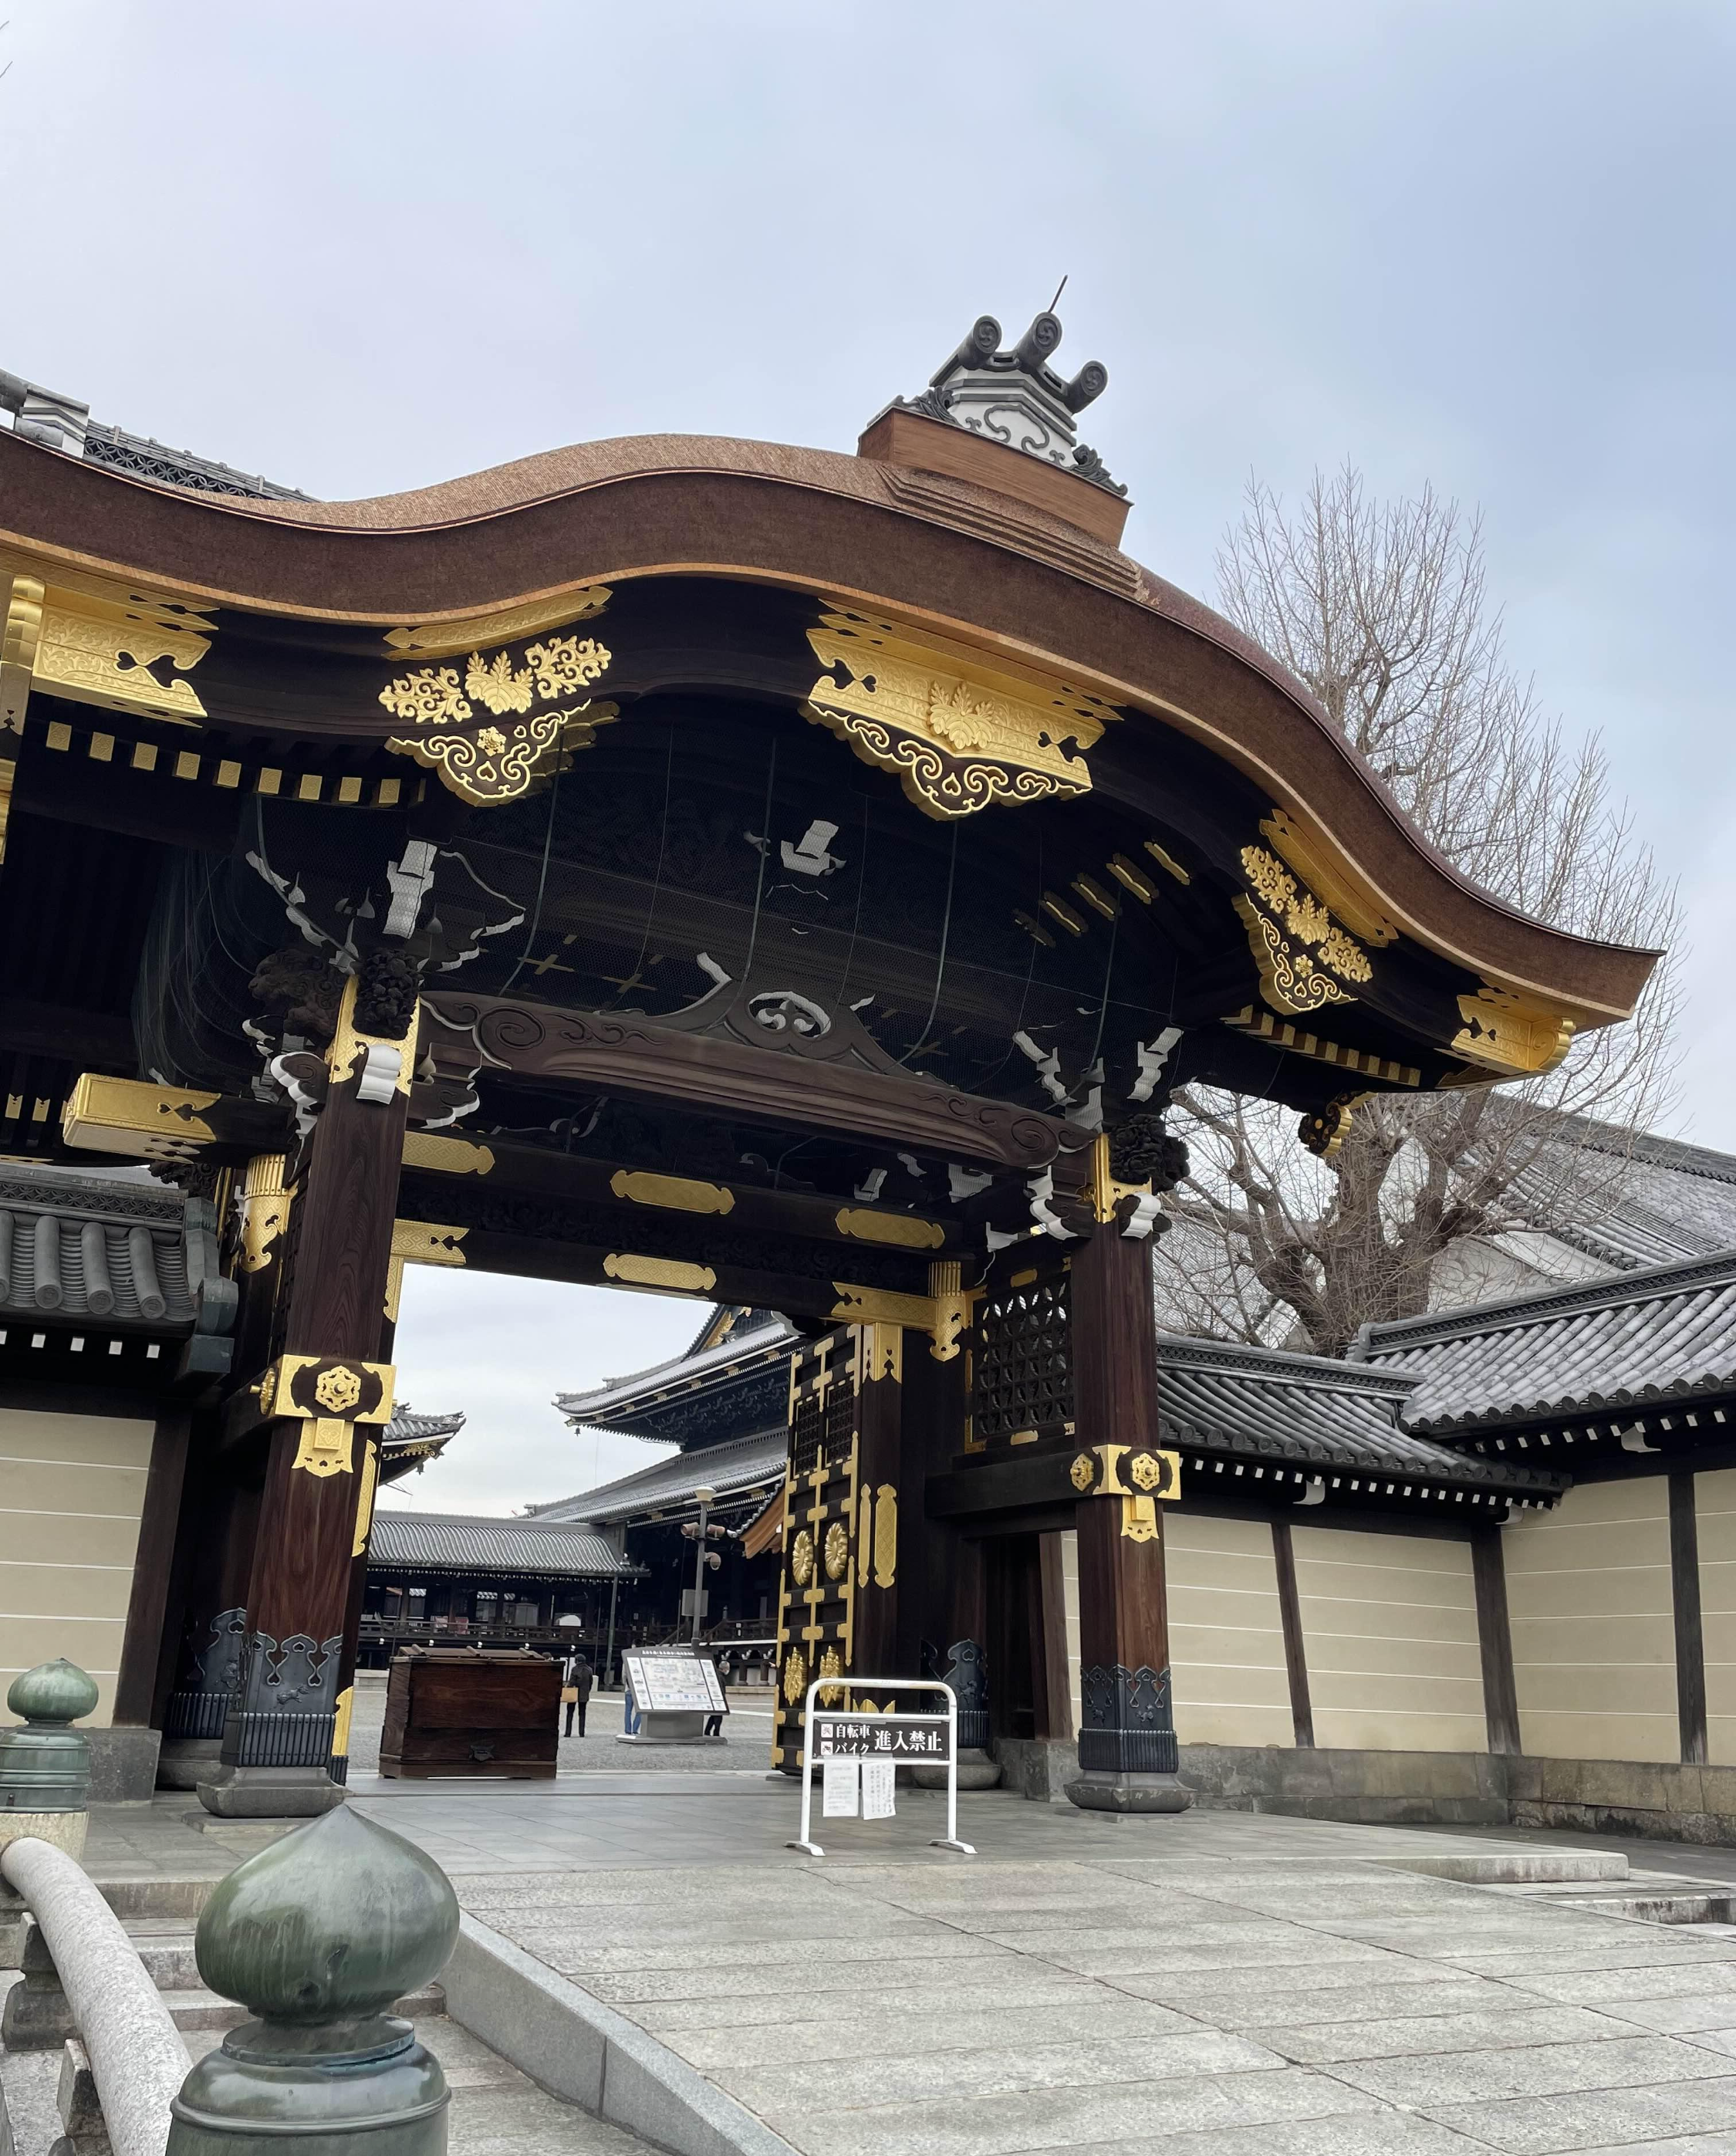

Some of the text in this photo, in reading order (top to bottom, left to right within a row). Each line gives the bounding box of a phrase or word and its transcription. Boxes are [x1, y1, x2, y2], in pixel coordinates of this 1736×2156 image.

[836, 1724, 870, 1739] 自転車
[874, 1730, 943, 1752] 進入禁止
[835, 1742, 870, 1756] バイク
